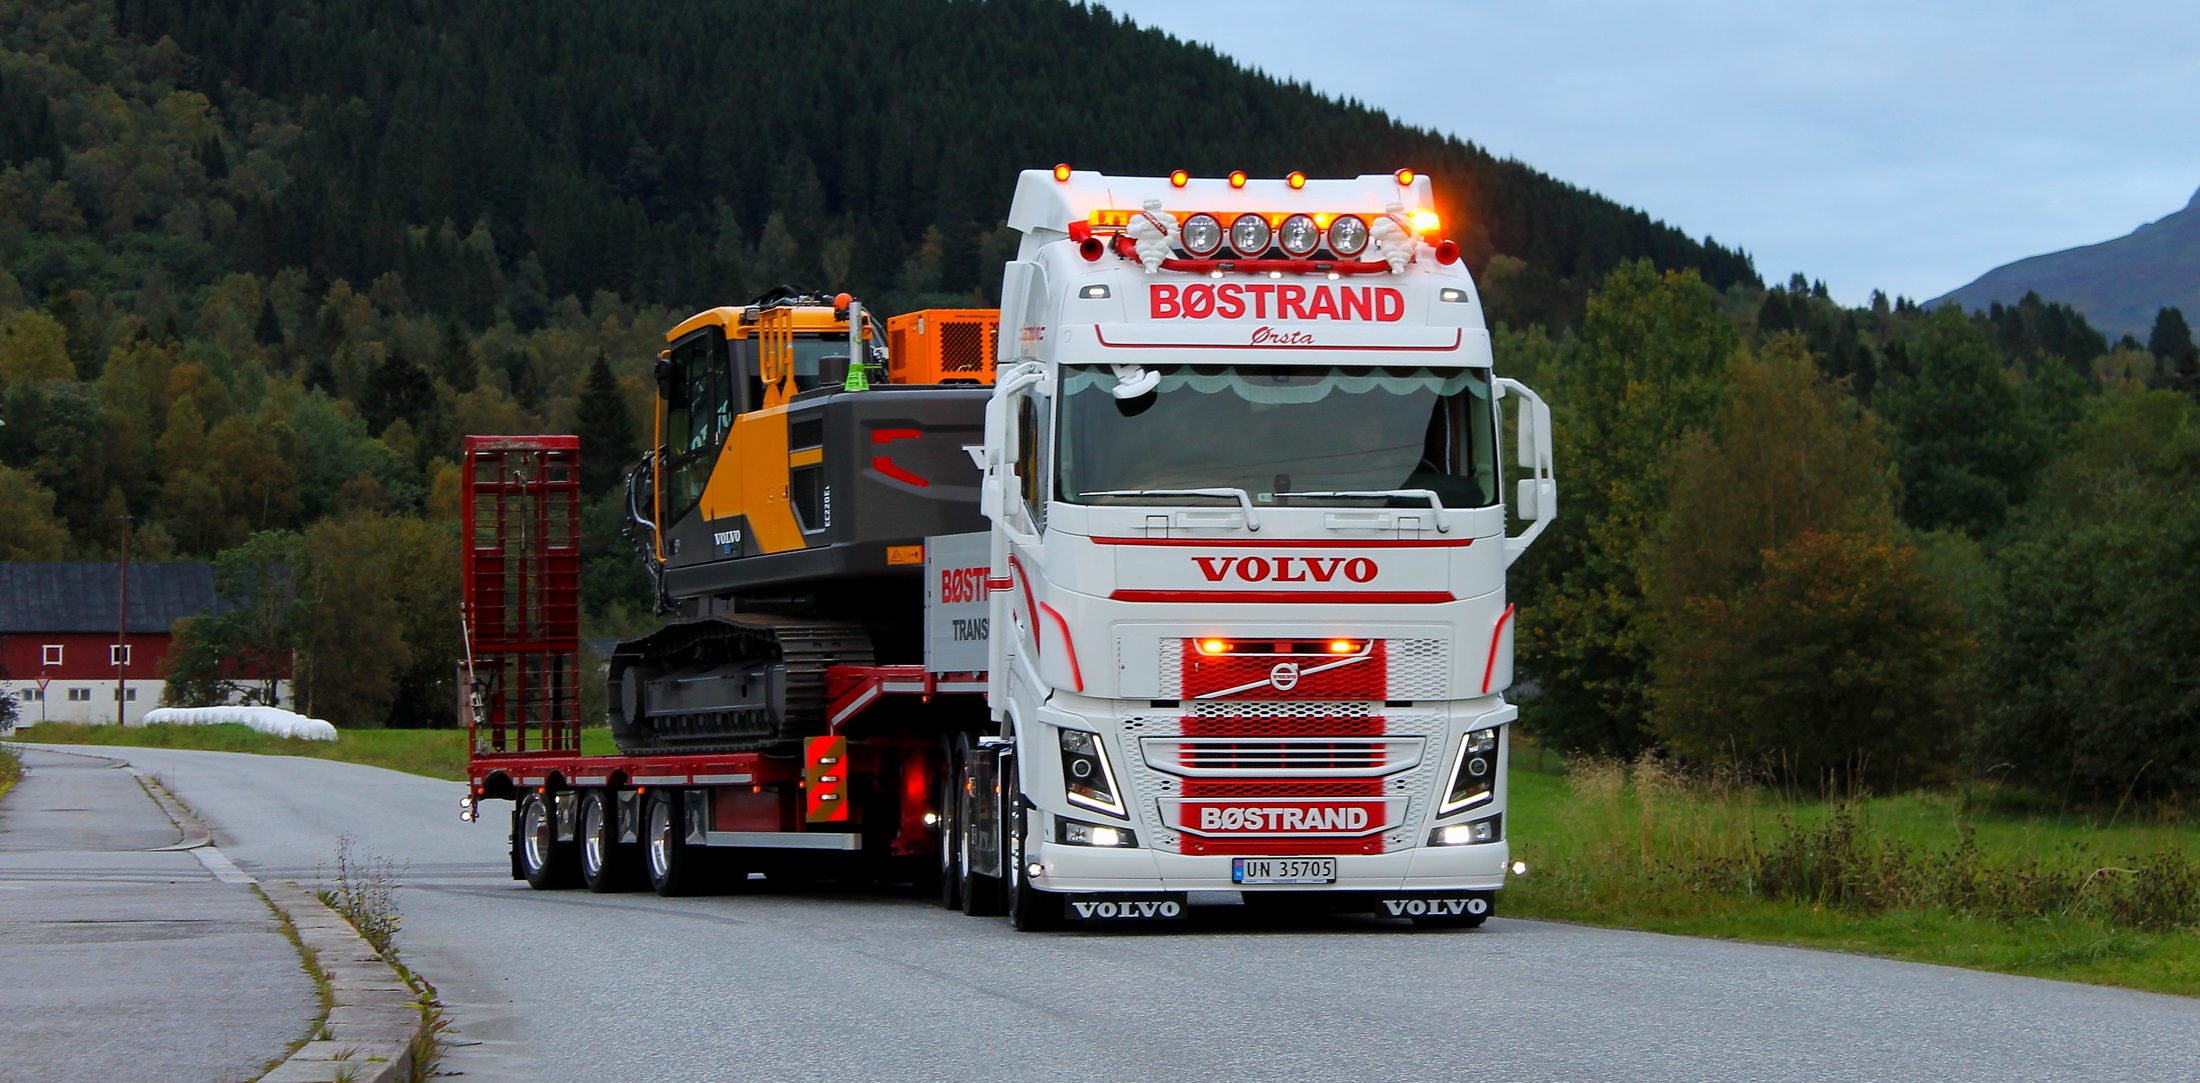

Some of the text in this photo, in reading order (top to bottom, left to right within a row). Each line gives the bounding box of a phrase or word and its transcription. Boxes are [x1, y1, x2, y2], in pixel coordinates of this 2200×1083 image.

[1150, 284, 1405, 322] BØSTRAND
[1251, 326, 1316, 345] Ørsta
[714, 530, 741, 545] VOLVO
[1191, 556, 1378, 583] VOLVO
[952, 618, 990, 641] TRANS
[1200, 807, 1369, 830] BØSTRAND
[1247, 861, 1332, 877] UN 35705
[1072, 901, 1180, 918] VOLVO
[1383, 899, 1488, 915] VOLVO
